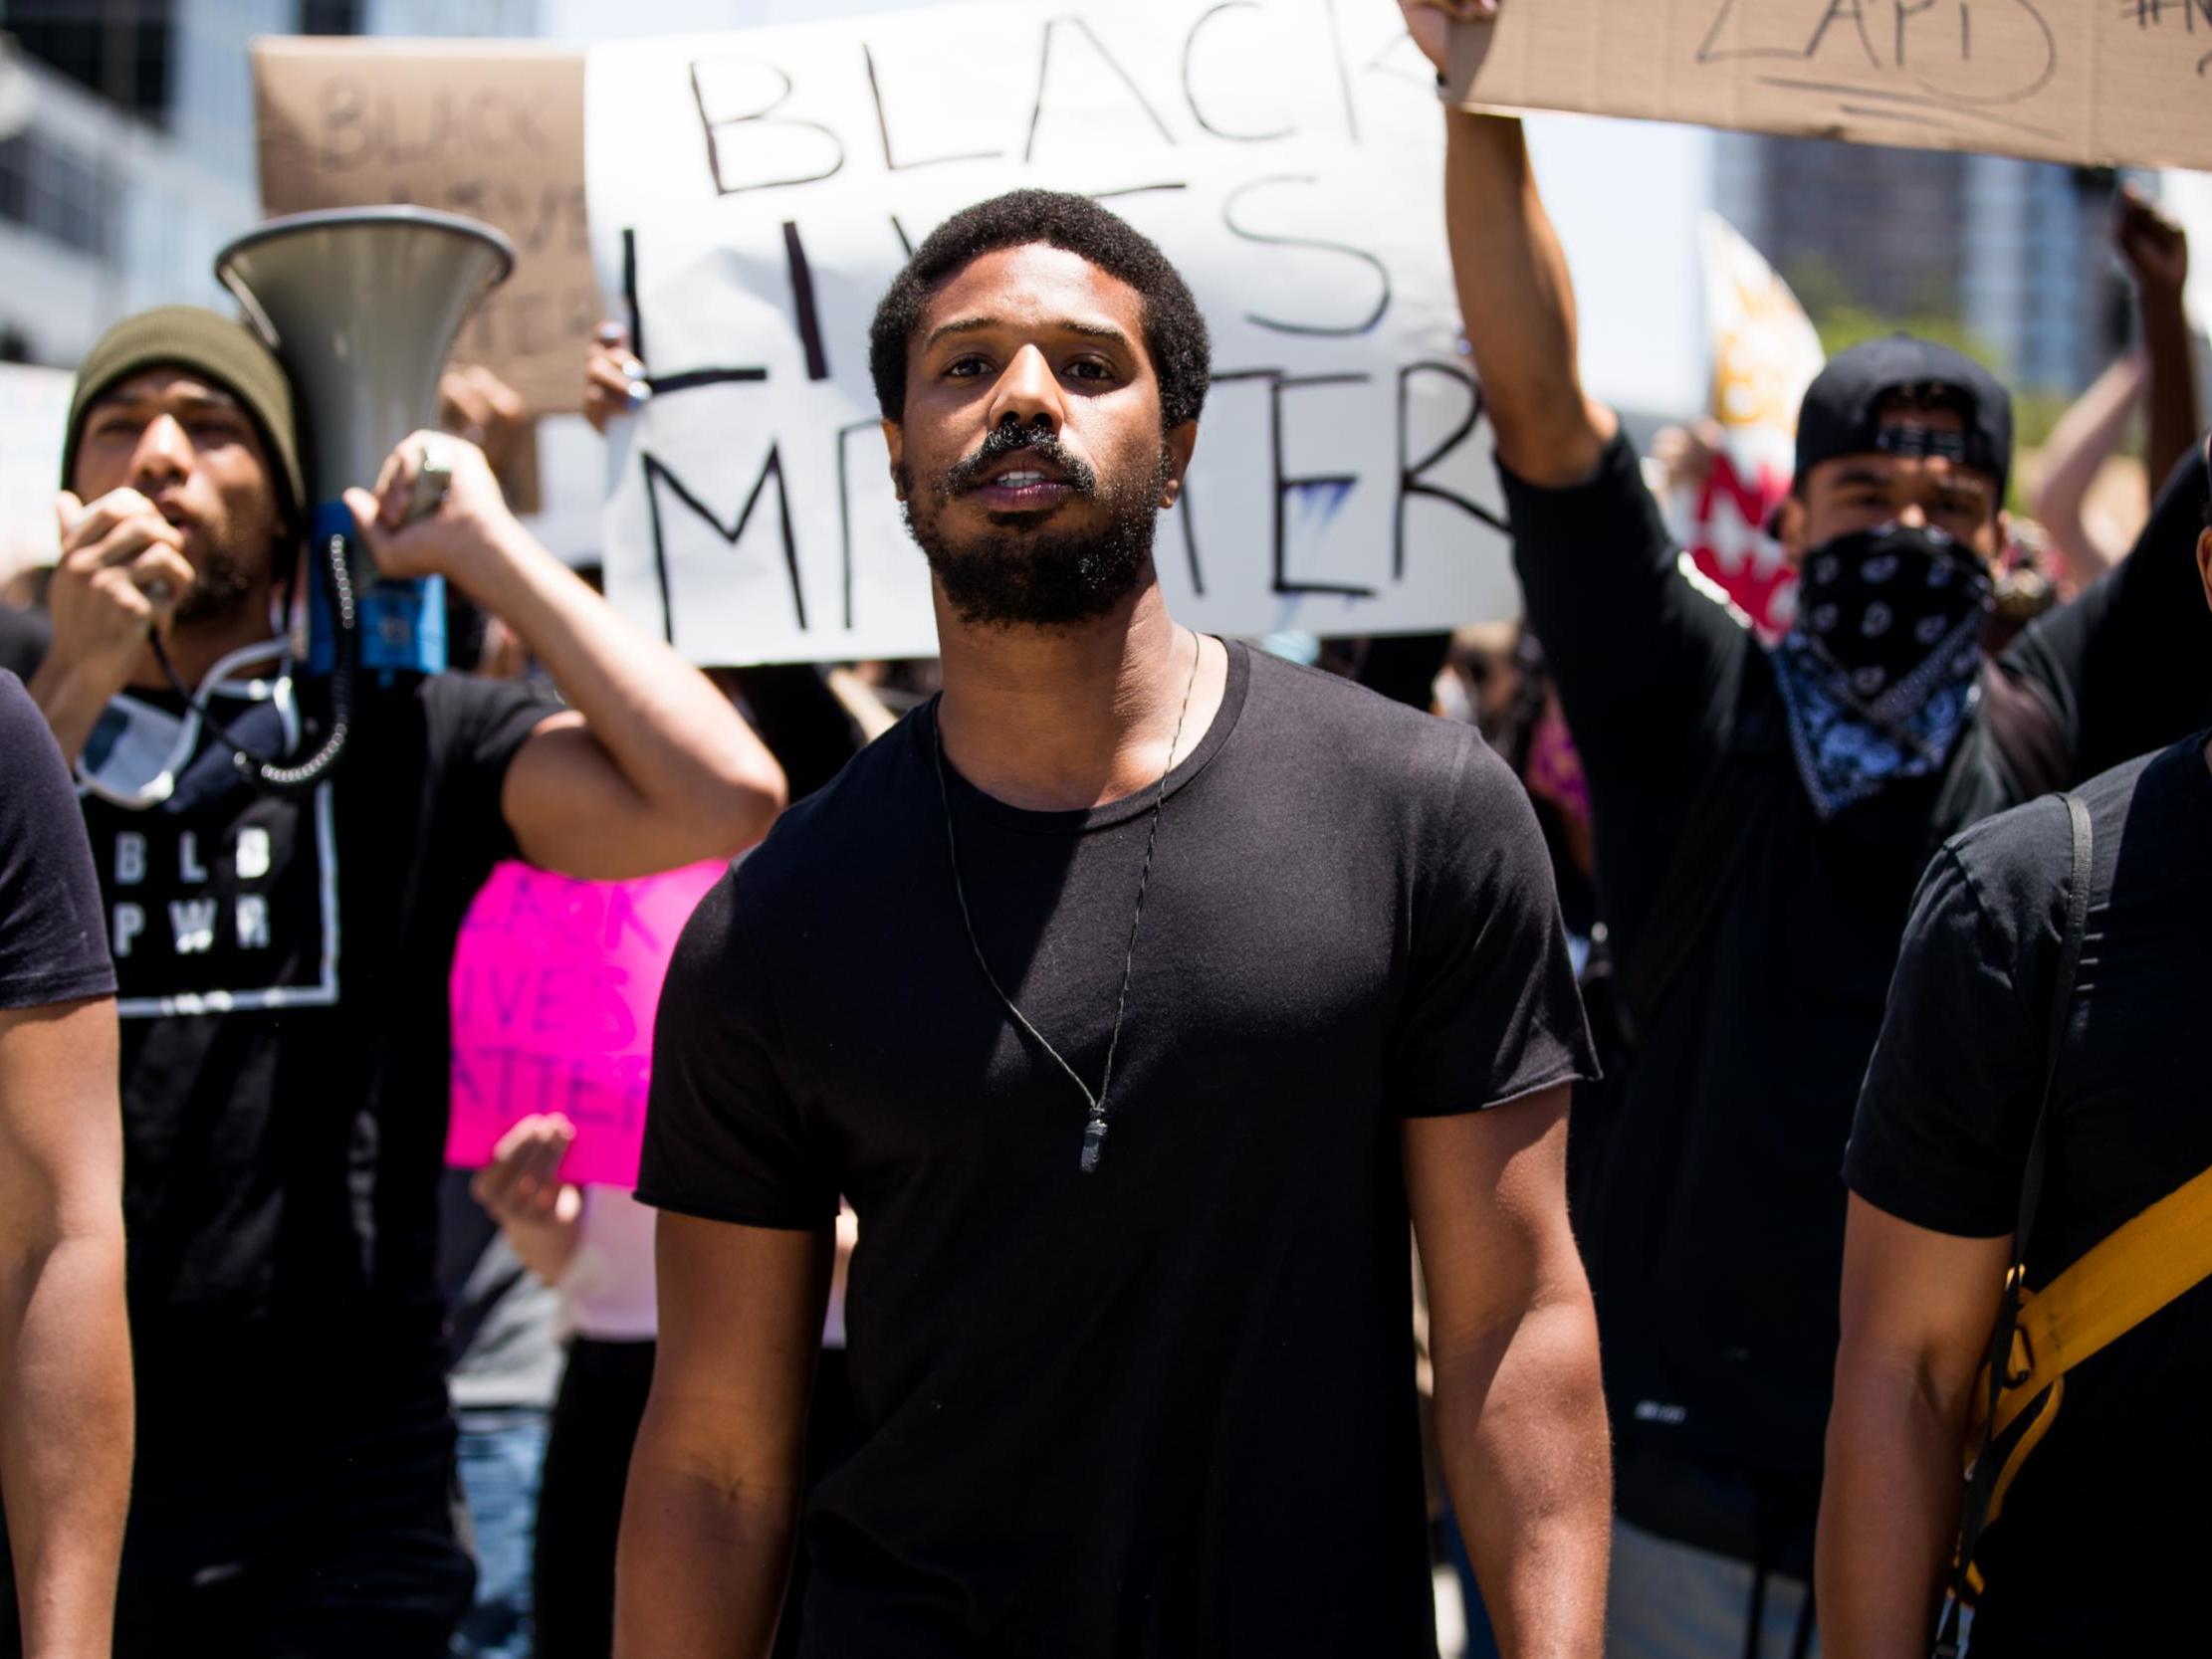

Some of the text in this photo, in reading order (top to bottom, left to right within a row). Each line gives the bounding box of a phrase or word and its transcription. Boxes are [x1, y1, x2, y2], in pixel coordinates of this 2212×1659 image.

[687, 1, 1434, 195] BLACK
[623, 174, 1391, 395] LIS
[112, 894, 270, 957] PWR
